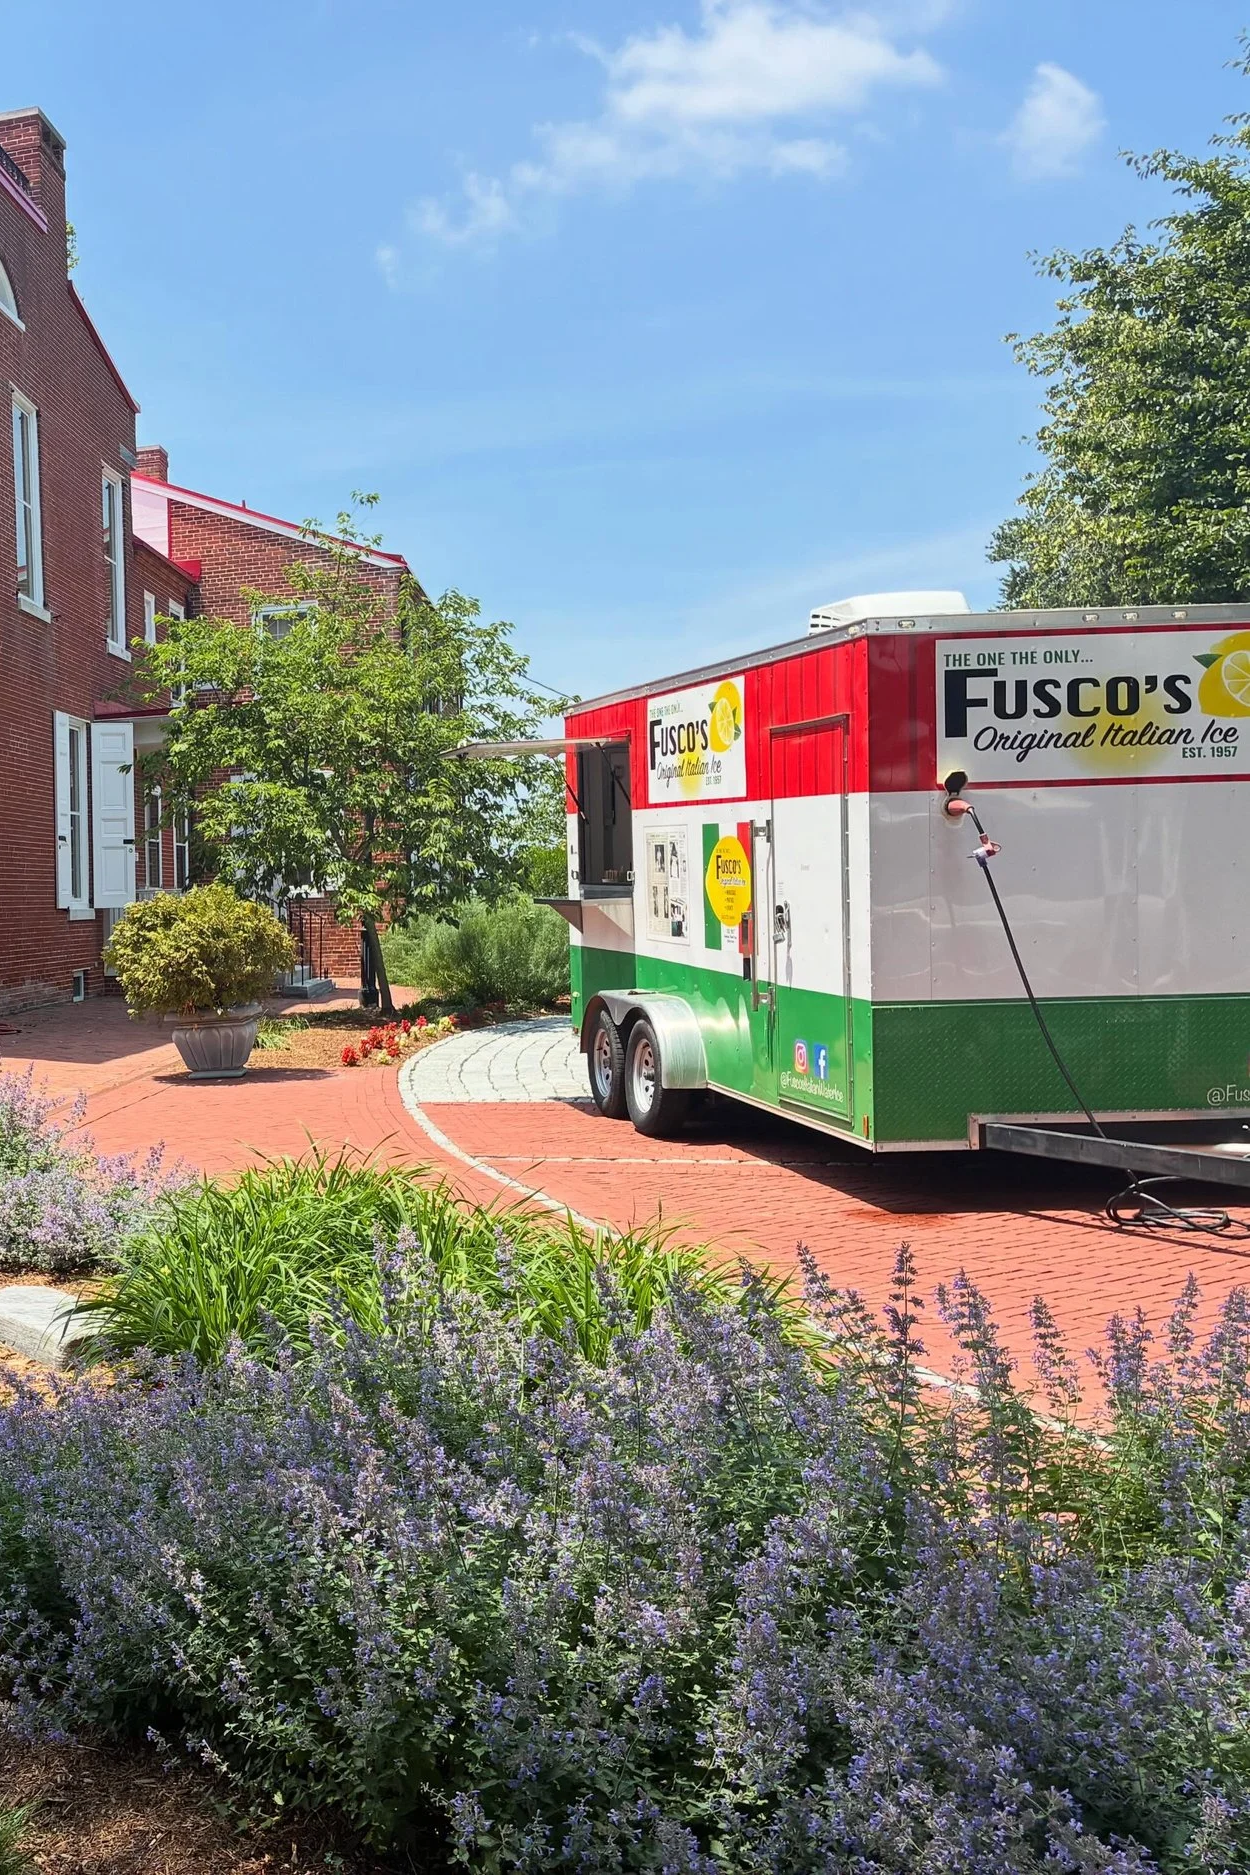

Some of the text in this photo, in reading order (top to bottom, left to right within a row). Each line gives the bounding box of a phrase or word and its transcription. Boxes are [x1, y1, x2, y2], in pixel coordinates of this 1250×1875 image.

[944, 649, 1093, 667] THE ONE THE ONLY...
[944, 668, 1192, 738] FUSCO'S
[650, 719, 708, 770] FUSCO'S
[973, 719, 1240, 763] Original Italian Ice
[1182, 746, 1237, 759] EST. 1957
[657, 755, 722, 788] Original Italian Ice
